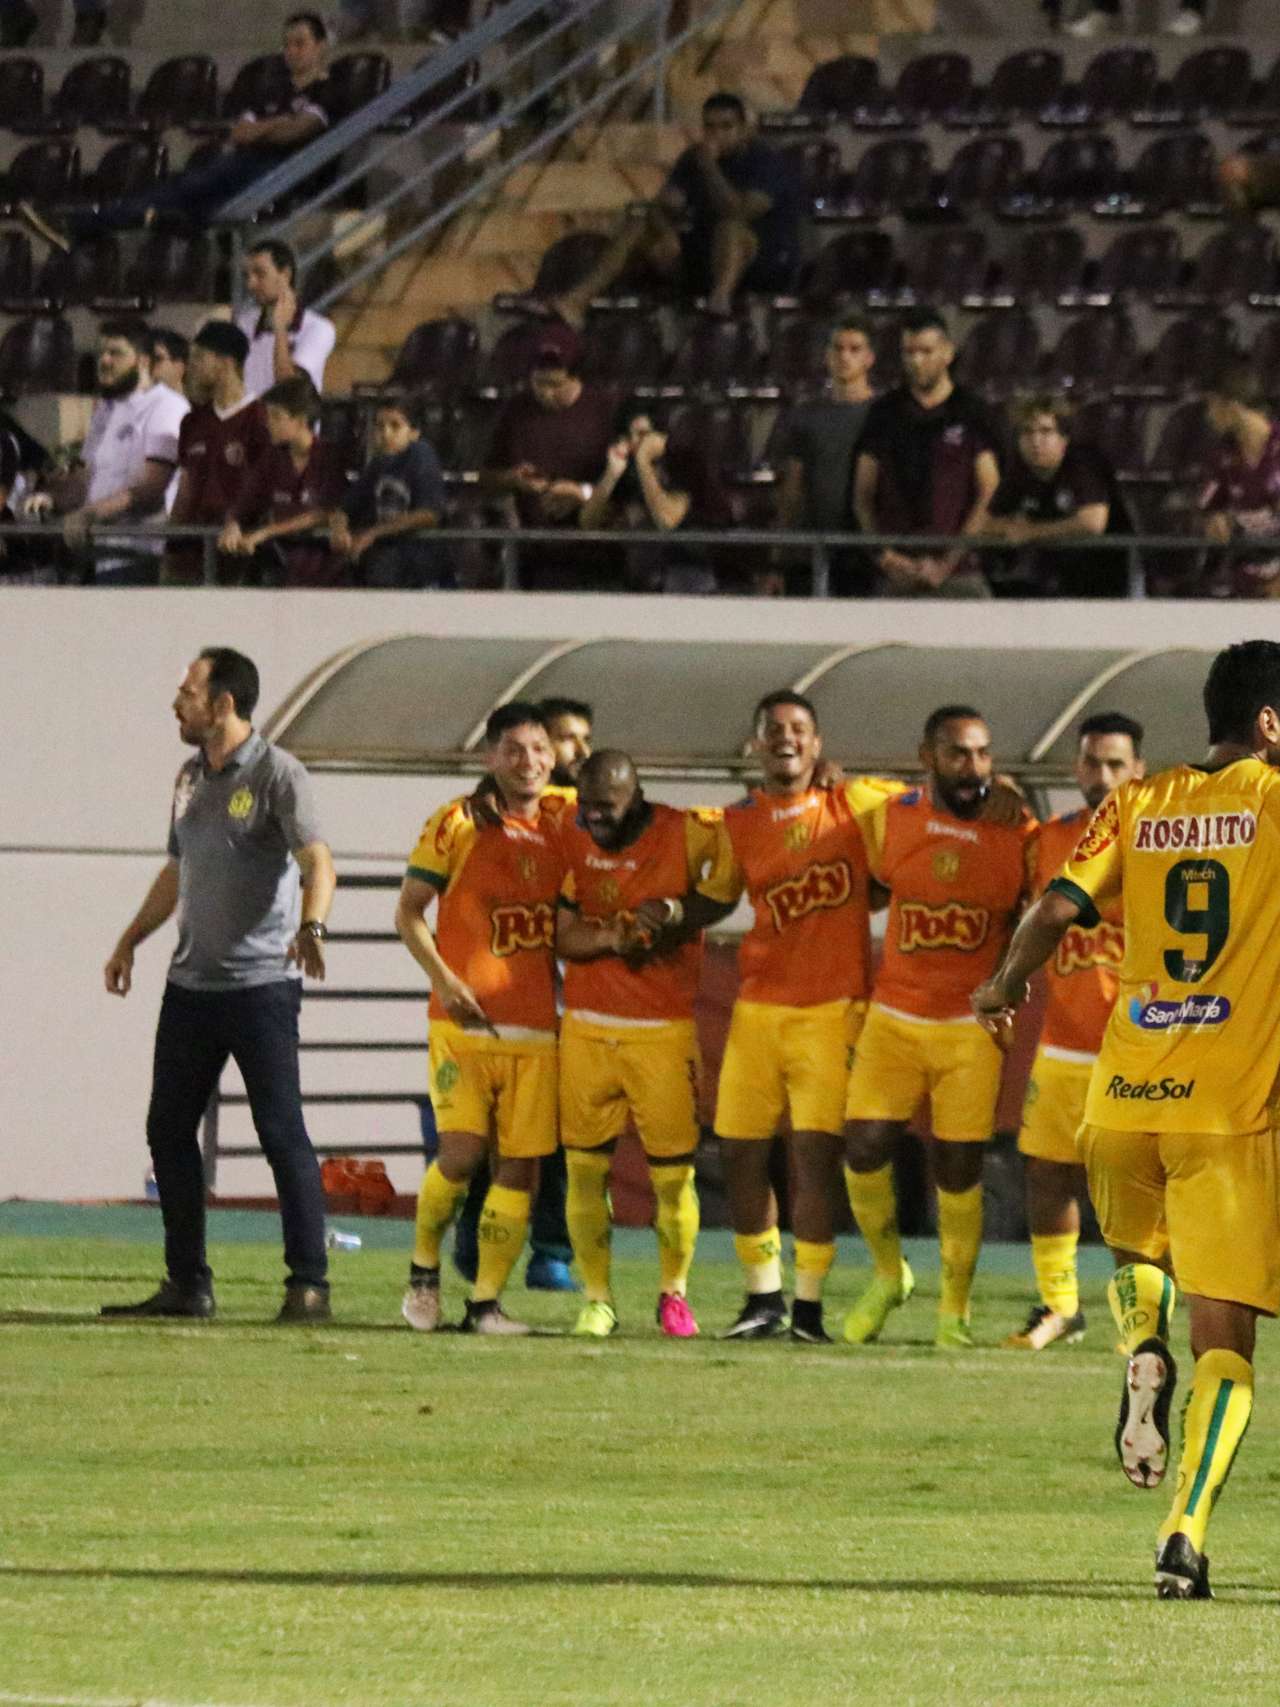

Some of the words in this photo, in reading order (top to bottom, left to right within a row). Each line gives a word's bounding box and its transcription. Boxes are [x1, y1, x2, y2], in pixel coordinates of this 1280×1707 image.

[901, 906, 988, 947] Poty
[1164, 859, 1230, 982] 9
[1105, 1075, 1195, 1101] RedeSol
